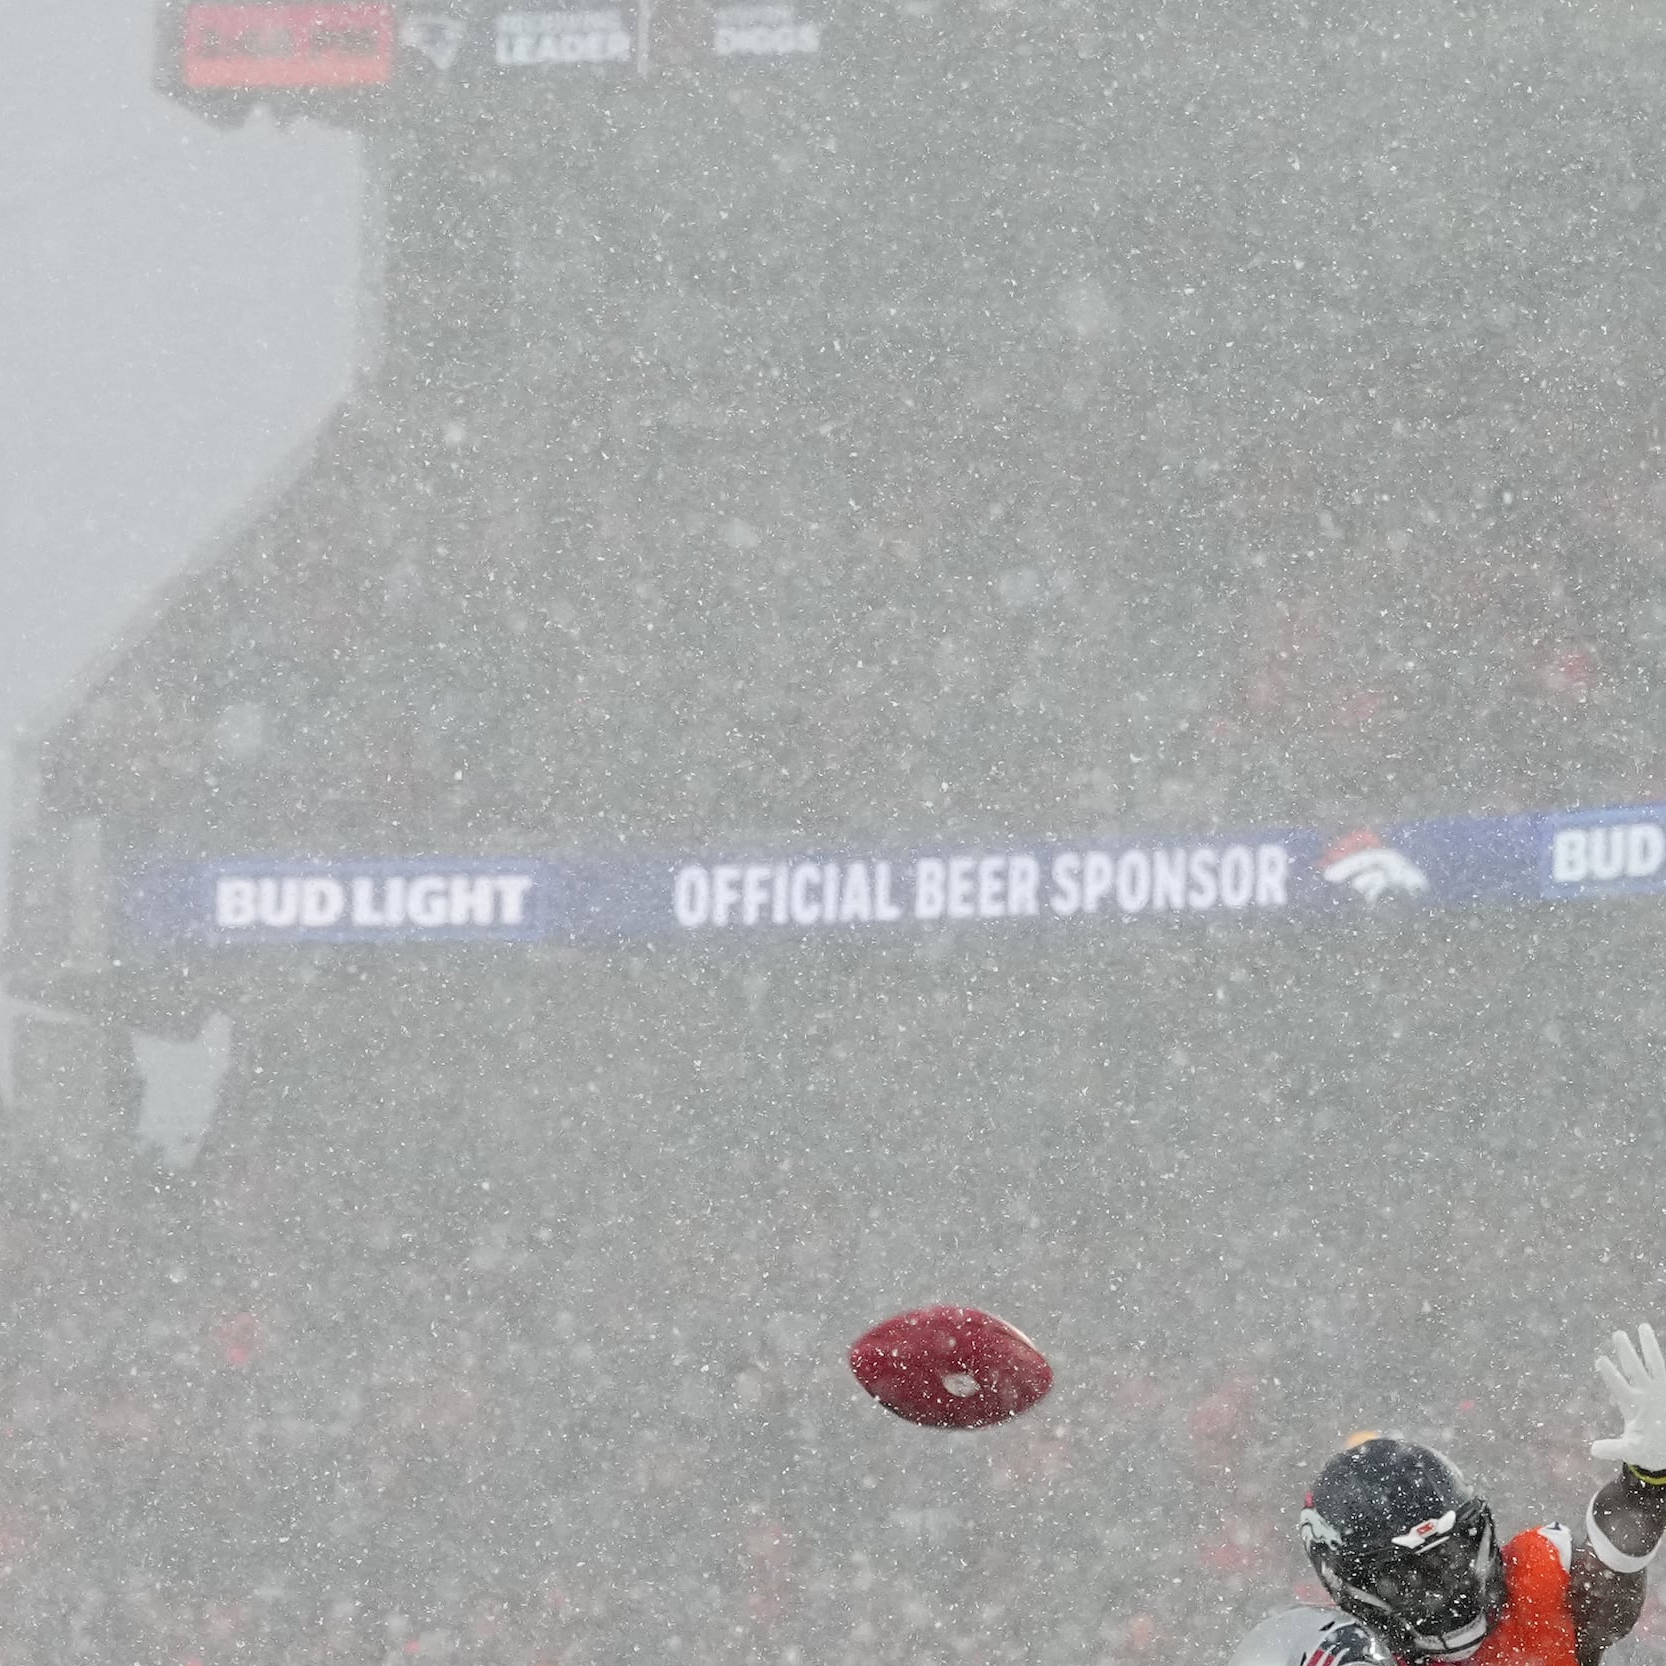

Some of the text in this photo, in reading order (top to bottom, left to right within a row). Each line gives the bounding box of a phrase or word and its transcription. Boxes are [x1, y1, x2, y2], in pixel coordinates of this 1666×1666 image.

[495, 31, 631, 65] LEADER
[1551, 823, 1666, 883] BUD
[216, 875, 532, 928] BUD LIGHT
[673, 844, 1290, 929] OFFICIAL BEER SPONSOR
